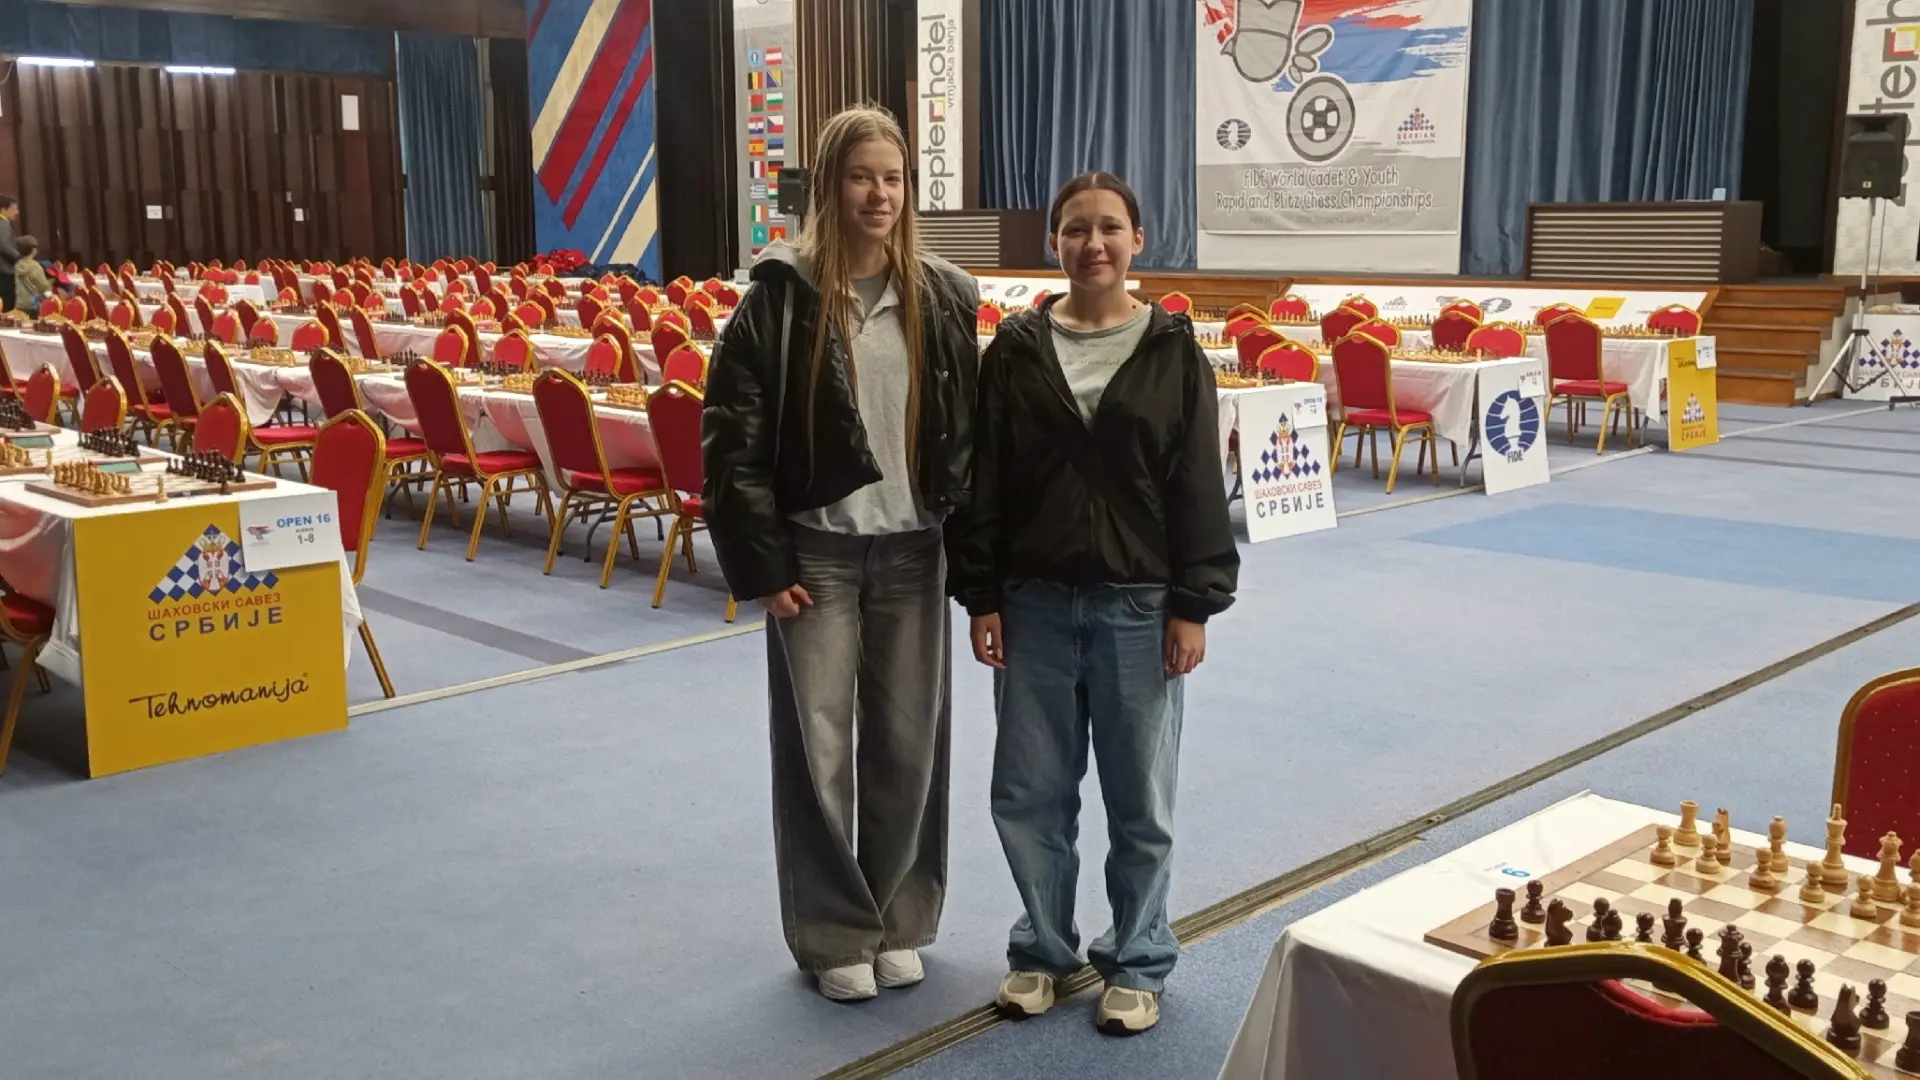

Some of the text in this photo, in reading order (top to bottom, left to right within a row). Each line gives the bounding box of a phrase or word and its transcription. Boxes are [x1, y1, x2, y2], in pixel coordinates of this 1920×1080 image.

[946, 19, 956, 53] banja
[1244, 166, 1399, 187] FIDE World Cadet & Youth
[1216, 188, 1433, 215] Rapid and Blitz Chess Championships
[1507, 450, 1523, 463] FIDE
[1254, 479, 1322, 499] ШАХОВСКИ САВЕЗ
[1256, 492, 1324, 518] СРБИЈЕ
[276, 513, 331, 528] OPEN 16
[297, 532, 315, 545] 1-8
[148, 592, 281, 620] ШАХОВСКИ САВЕЗ
[149, 606, 283, 641] СРБИЈЕ
